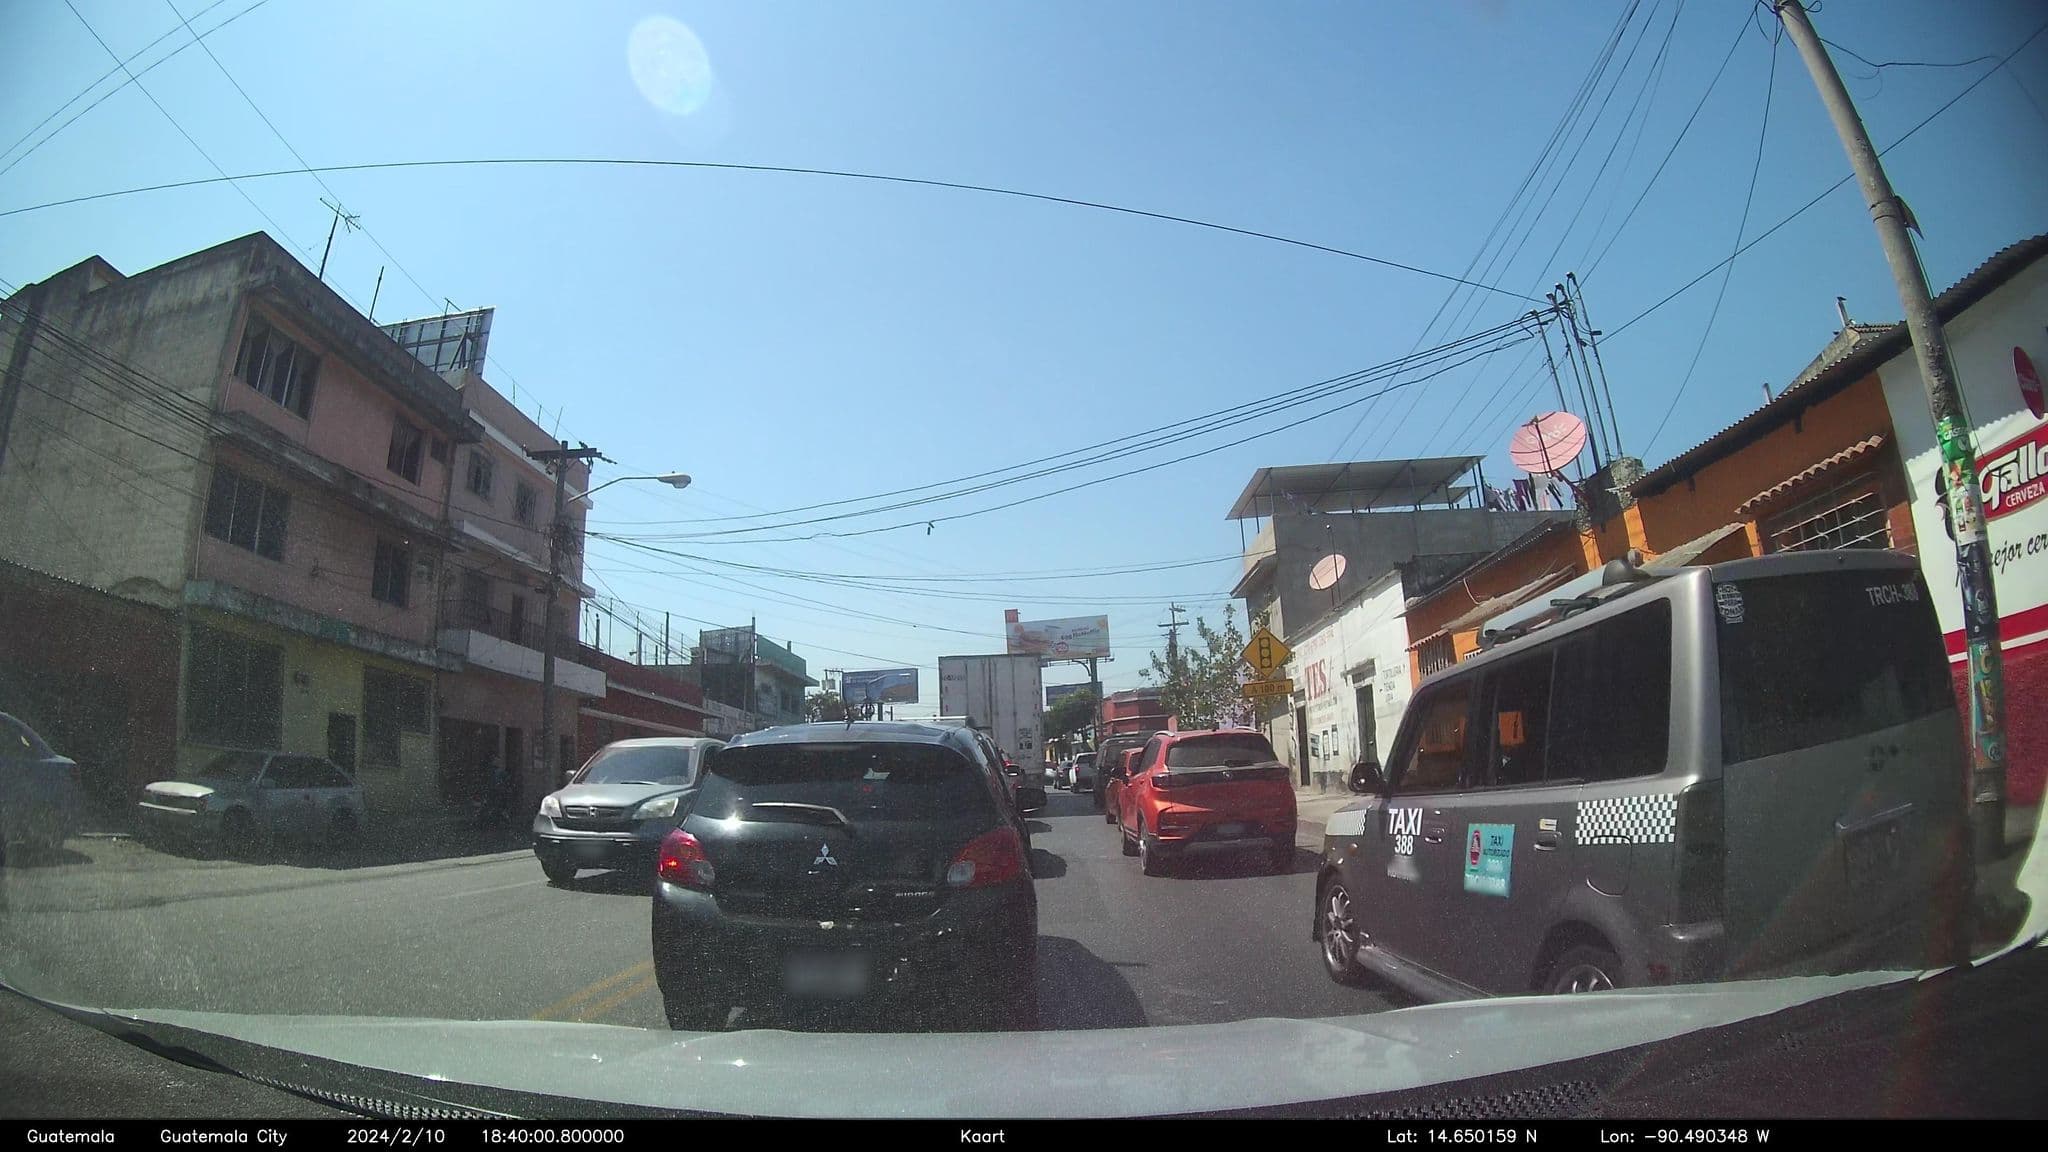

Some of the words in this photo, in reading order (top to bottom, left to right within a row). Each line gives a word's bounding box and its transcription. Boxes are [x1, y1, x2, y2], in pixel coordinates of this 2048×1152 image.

[2005, 481, 2046, 508] CERVEZA
[1992, 540, 2022, 575] ejor
[1388, 807, 1423, 836] TAXI
[1394, 835, 1414, 855] 388
